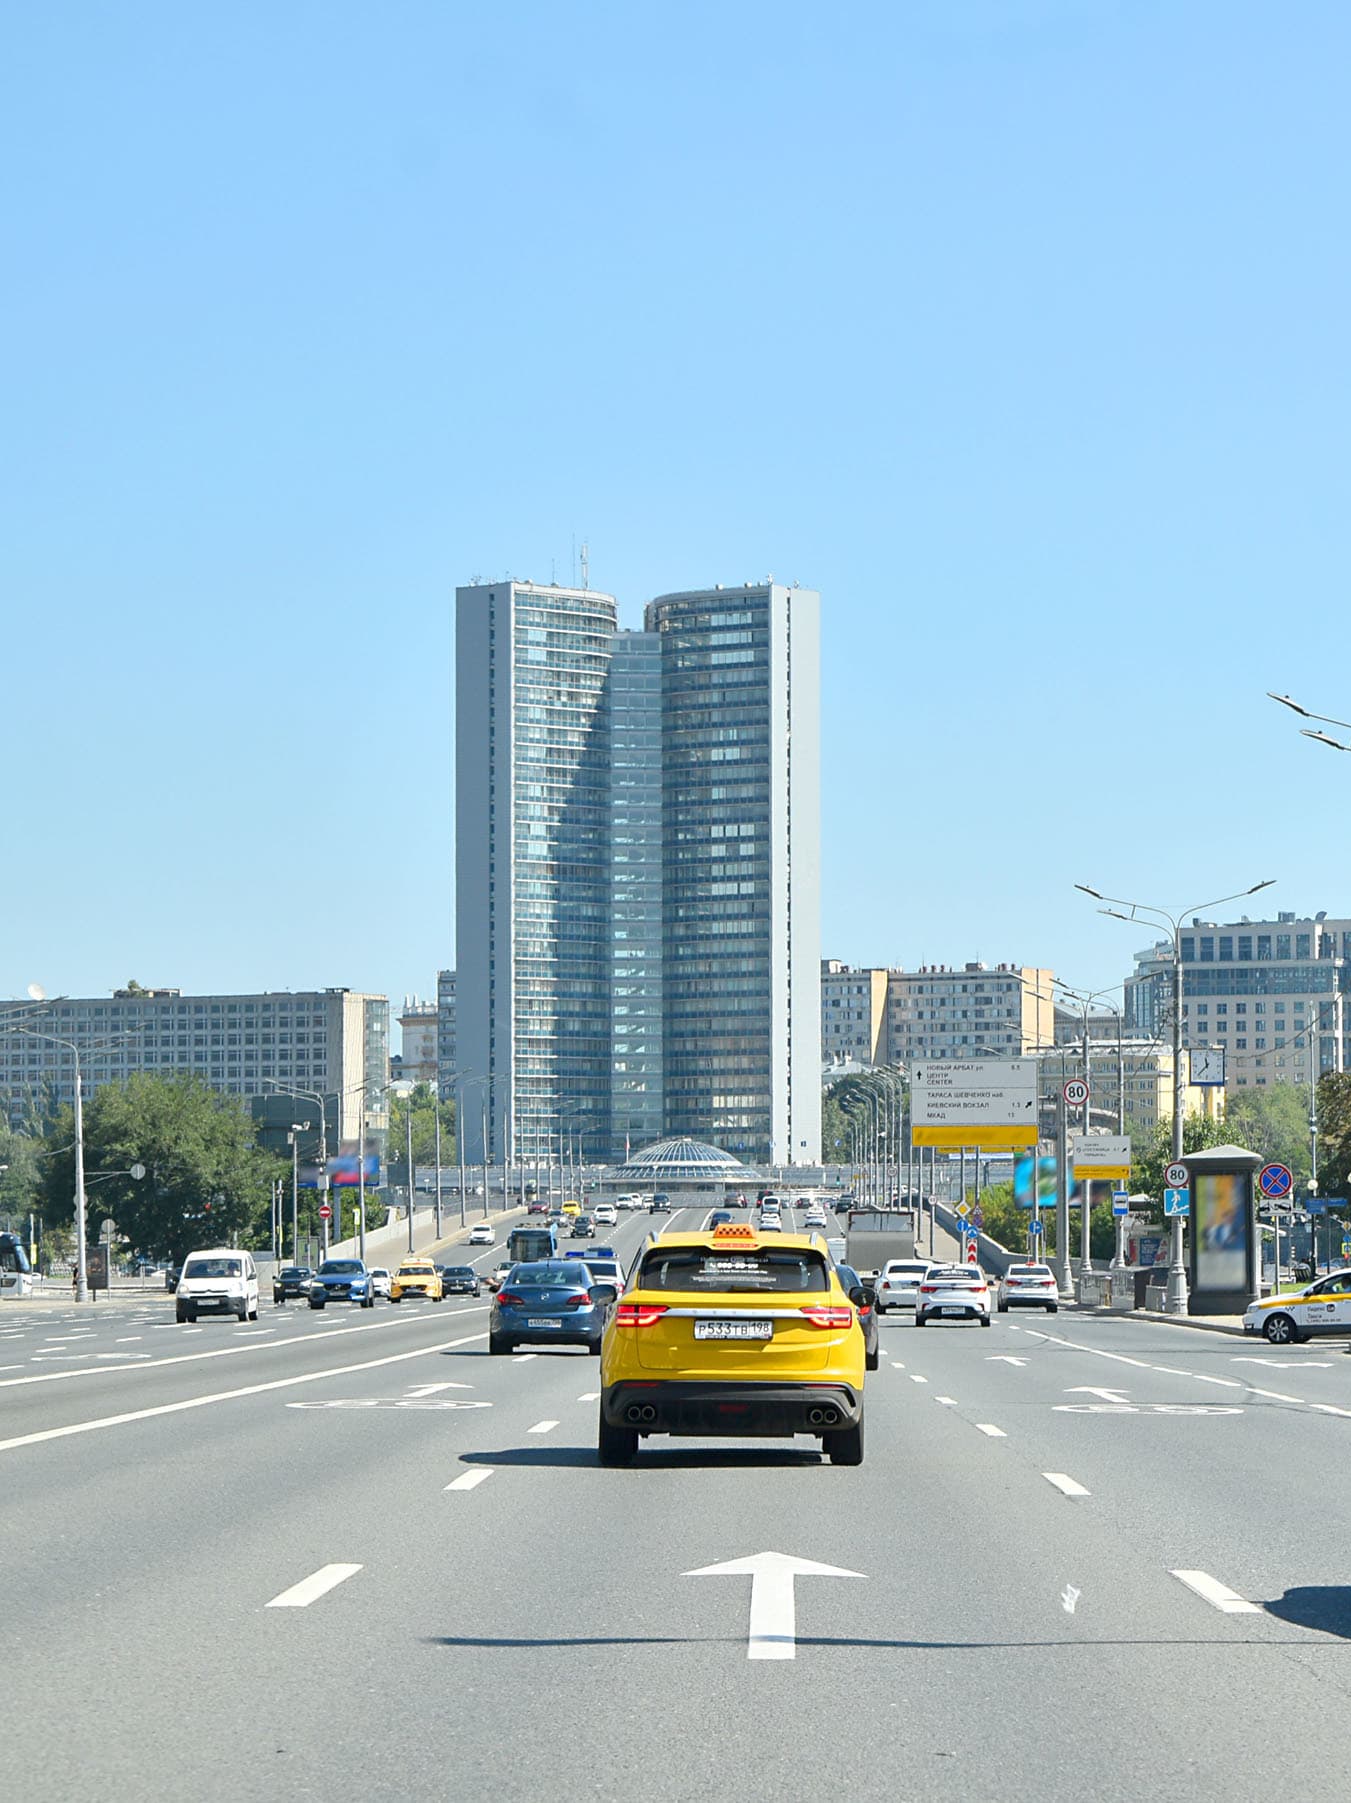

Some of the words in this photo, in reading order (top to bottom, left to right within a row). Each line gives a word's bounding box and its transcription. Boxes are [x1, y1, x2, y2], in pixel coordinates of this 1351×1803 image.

[1068, 1086, 1084, 1098] 80
[926, 1112, 946, 1120] МКАД
[1170, 1169, 1185, 1180] 80
[699, 1322, 748, 1335] Р533ТВ
[751, 1322, 769, 1332] 198
